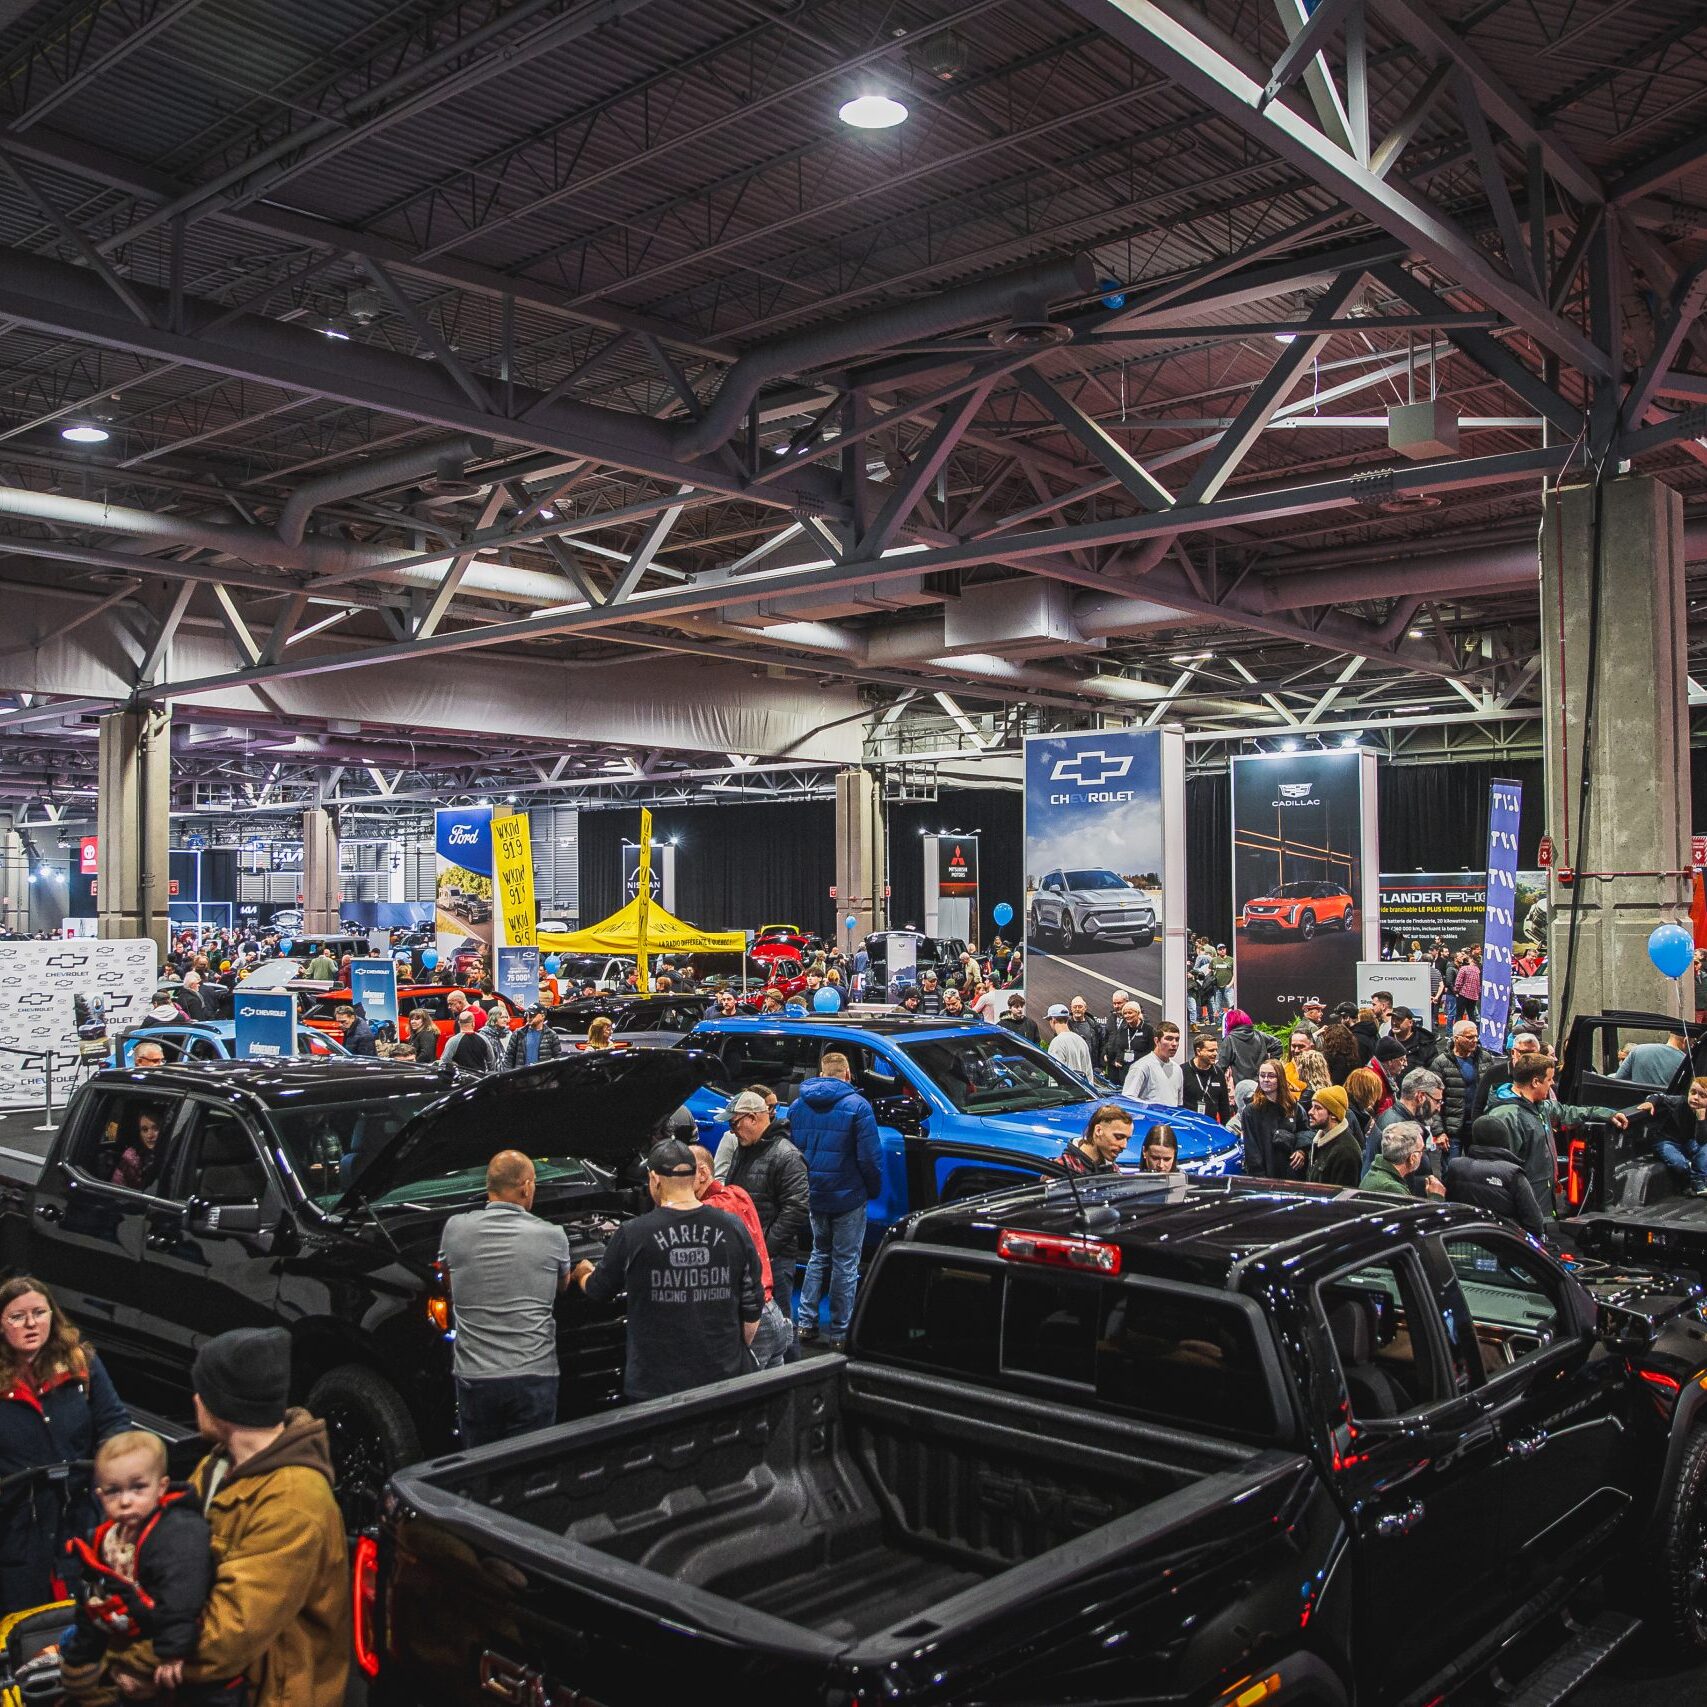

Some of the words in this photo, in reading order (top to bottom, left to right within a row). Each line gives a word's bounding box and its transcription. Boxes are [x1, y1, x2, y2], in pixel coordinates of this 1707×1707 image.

[1050, 790, 1135, 805] CHEVROLET
[1271, 799, 1321, 807] CADILLAC
[448, 824, 479, 845] Ford
[627, 881, 660, 889] NISAN
[255, 1009, 287, 1017] CHEVROLET
[650, 1266, 731, 1288] DAVIDSON
[651, 1289, 687, 1303] RACING
[693, 1287, 731, 1302] DIVISION
